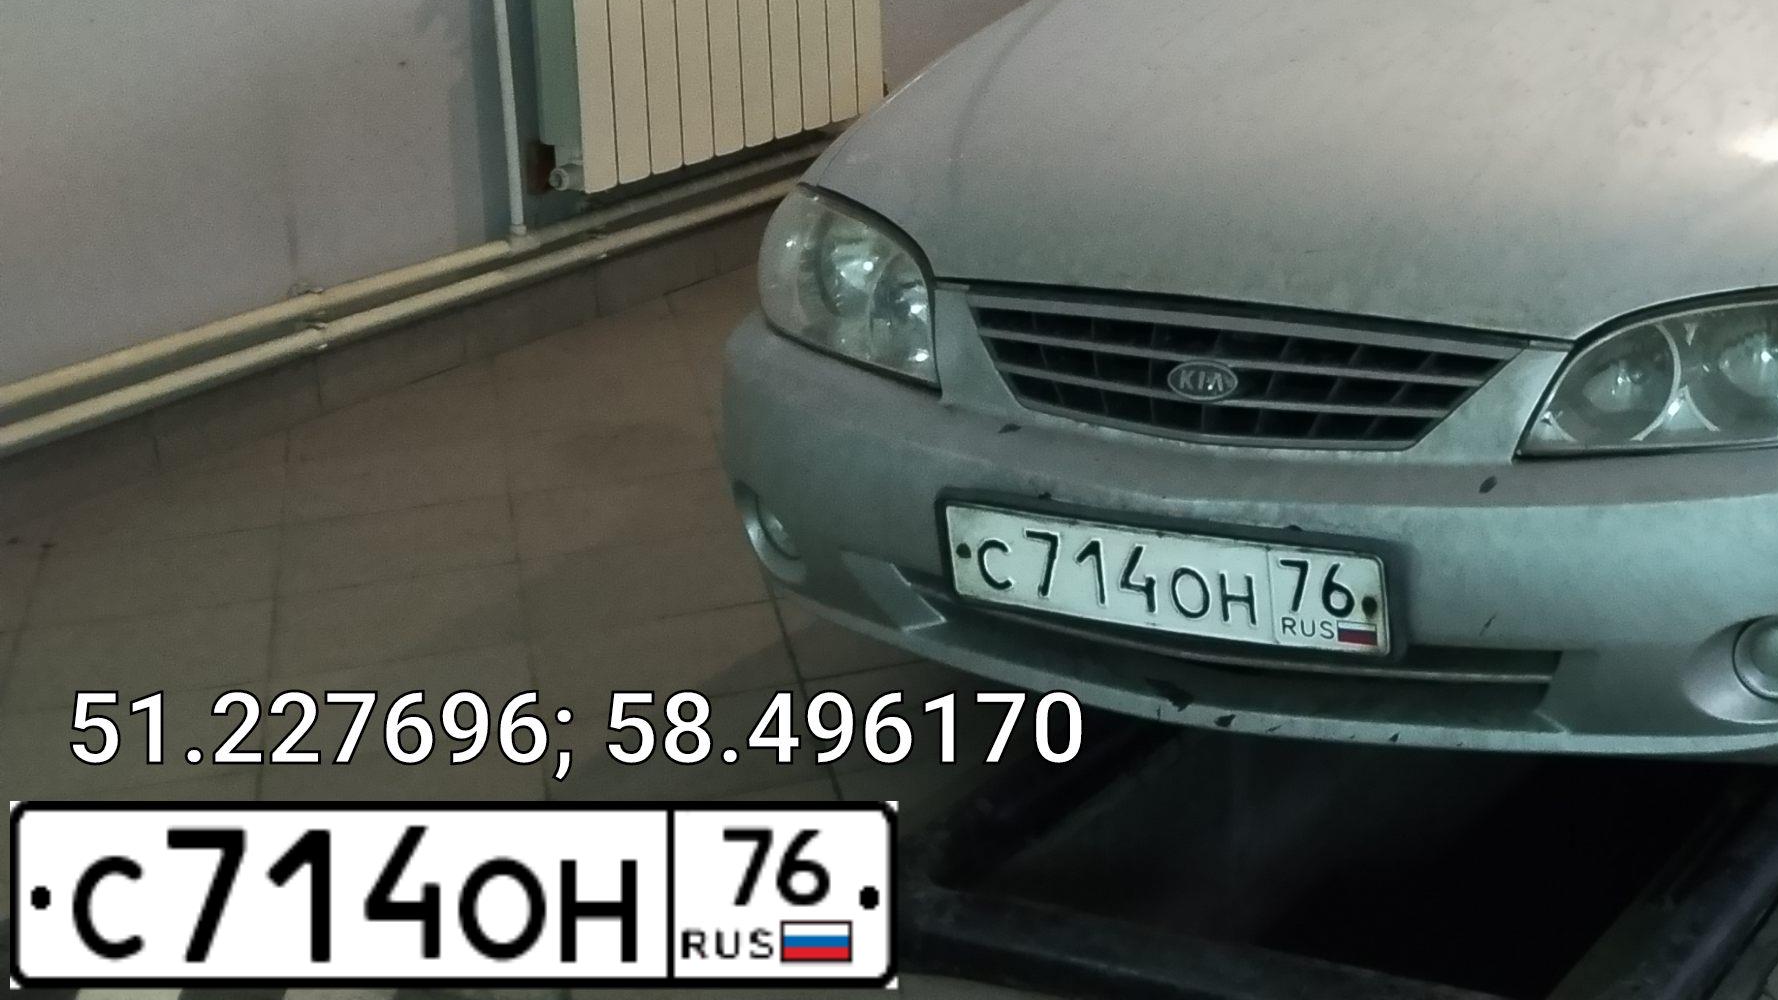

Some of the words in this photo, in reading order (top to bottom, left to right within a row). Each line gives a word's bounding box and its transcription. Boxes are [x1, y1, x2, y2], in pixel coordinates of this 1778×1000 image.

[1180, 370, 1223, 391] KIA
[1279, 559, 1355, 618] 76
[1281, 616, 1335, 640] RUS
